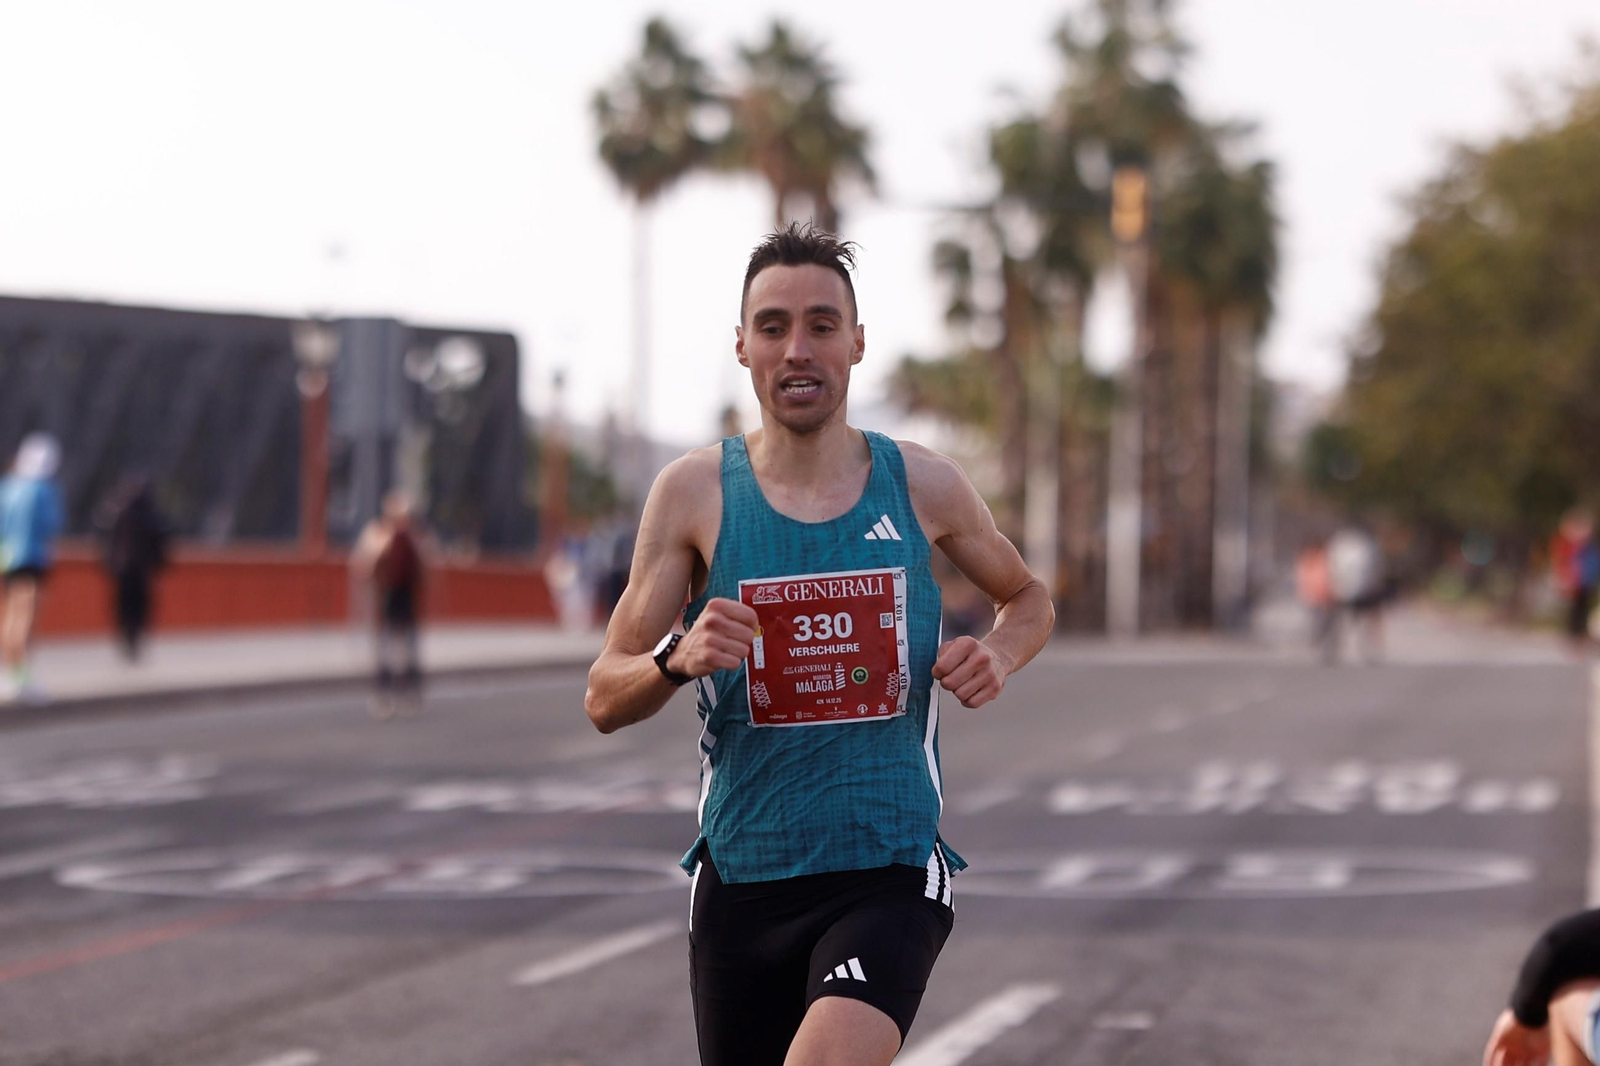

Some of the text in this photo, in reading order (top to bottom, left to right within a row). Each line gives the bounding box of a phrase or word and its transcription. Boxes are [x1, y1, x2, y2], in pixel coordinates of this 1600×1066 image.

[784, 576, 885, 602] GENERALI
[895, 603, 903, 622] BOX
[793, 611, 853, 642] 330
[788, 643, 860, 658] VERSCHUERE
[794, 663, 832, 673] GENERALI
[795, 679, 834, 694] MÁLAGA
[899, 672, 908, 690] BOX
